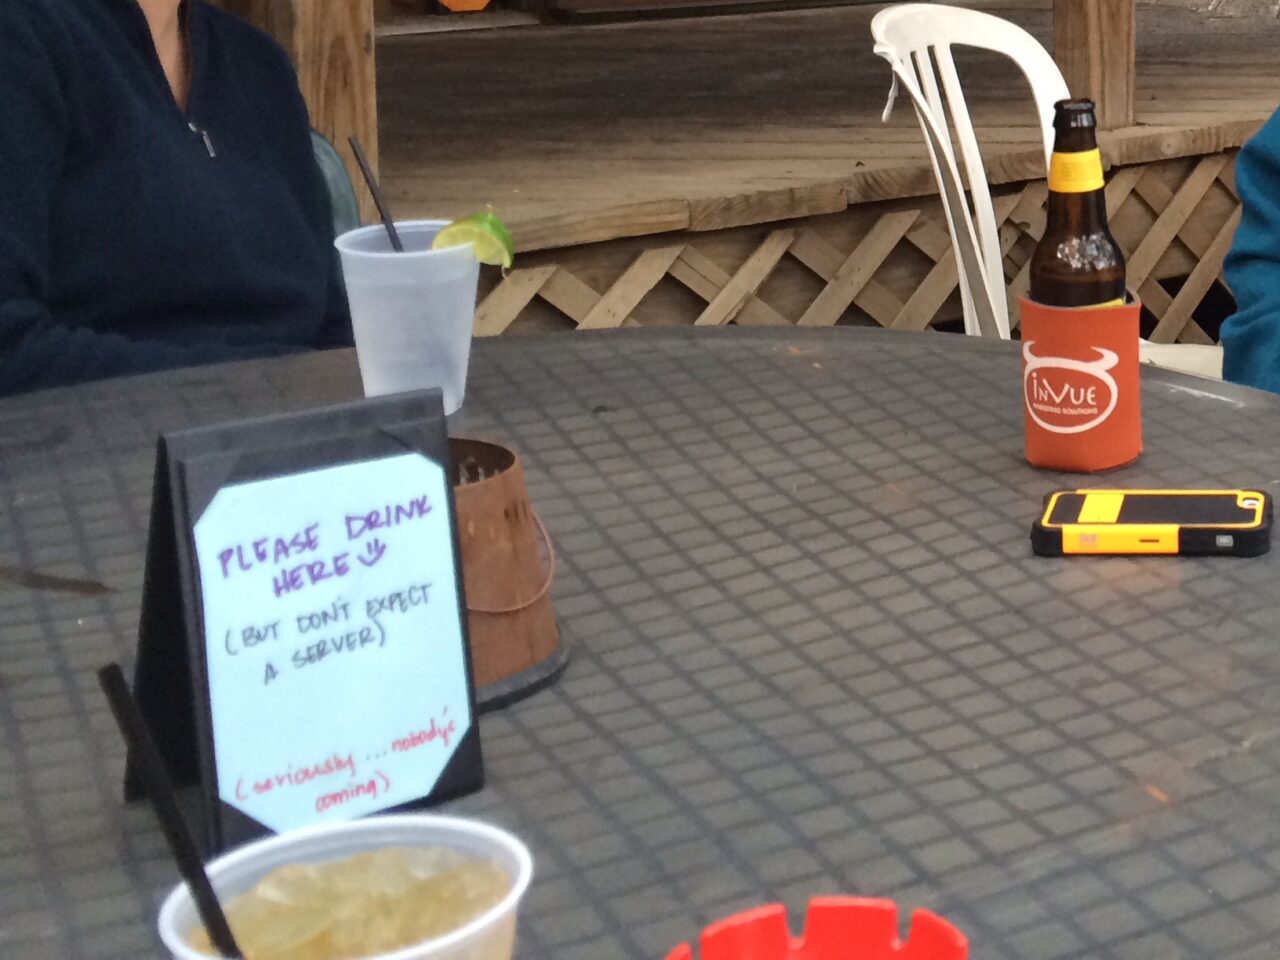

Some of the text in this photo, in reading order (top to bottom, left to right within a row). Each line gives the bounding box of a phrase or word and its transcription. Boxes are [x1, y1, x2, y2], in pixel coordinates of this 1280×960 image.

[217, 494, 433, 579] PLEASE DRINK
[272, 552, 350, 599] HERE
[224, 581, 433, 656] (BUT DON'T EXPECT
[263, 619, 386, 686] A SERVER)
